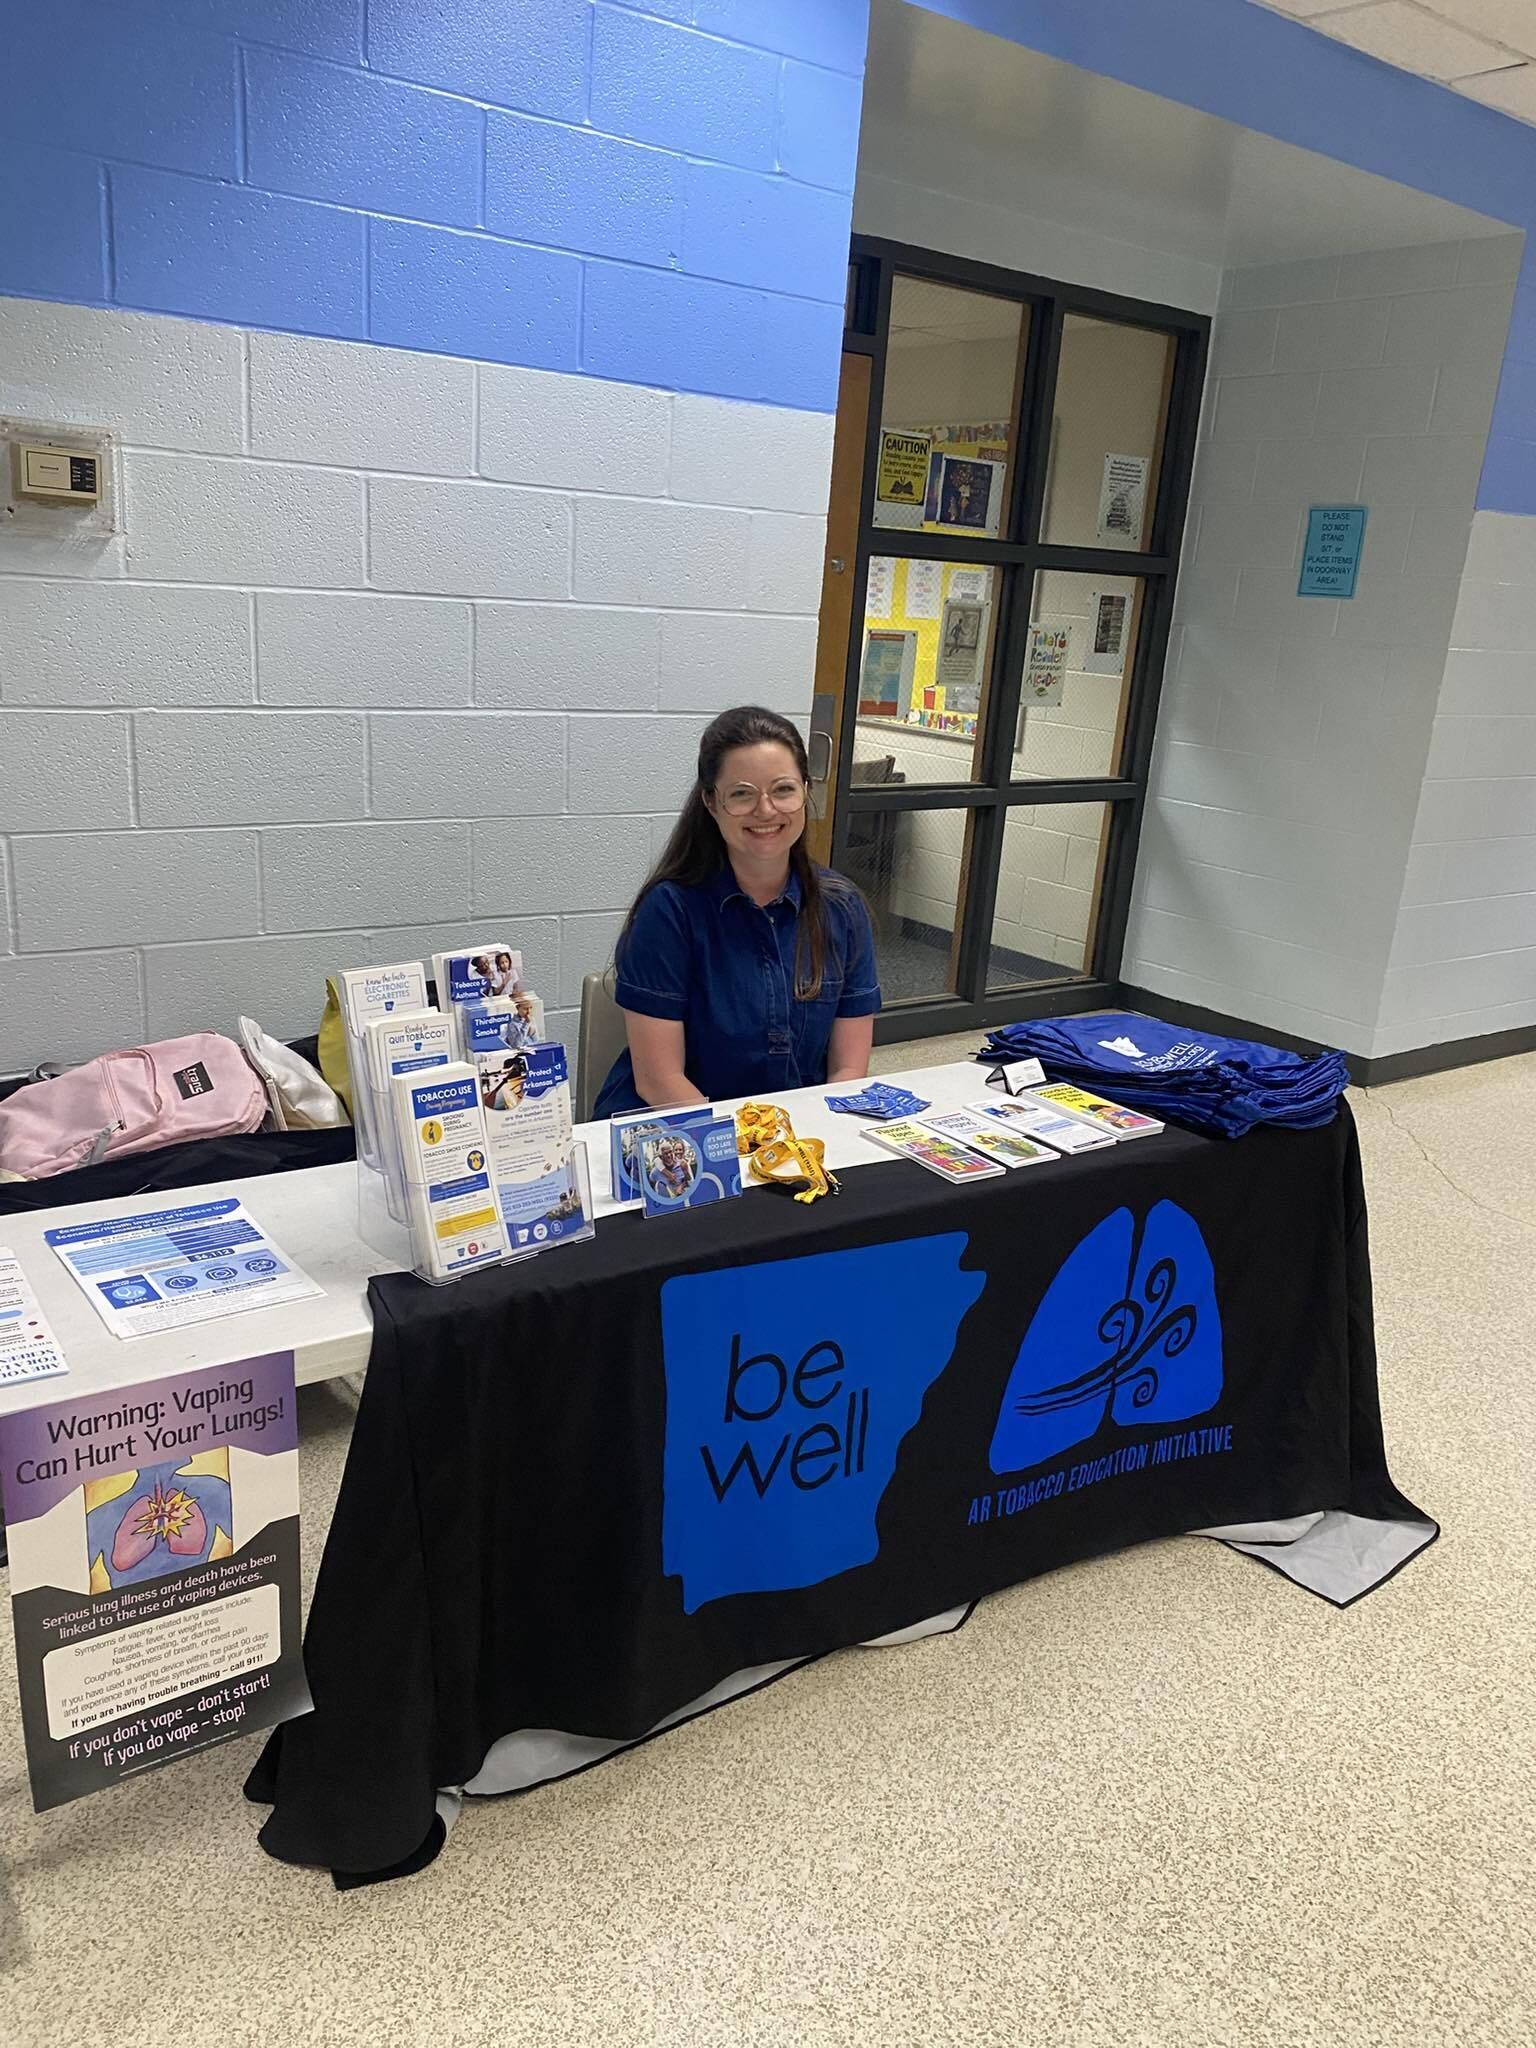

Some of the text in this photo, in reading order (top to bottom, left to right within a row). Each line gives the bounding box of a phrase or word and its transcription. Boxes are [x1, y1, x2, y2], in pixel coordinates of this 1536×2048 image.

[886, 438, 927, 454] CAUTION
[364, 981, 410, 995] ELECTRONIC
[367, 990, 410, 1003] CIGARETTES
[455, 981, 480, 990] Tobacco
[455, 991, 479, 1000] Asthma
[389, 1029, 446, 1044] QUIT TOBACCO?
[475, 1015, 510, 1026] Thirdhand
[475, 1028, 499, 1037] Smoke
[187, 1068, 204, 1094] trans
[523, 1079, 553, 1090] Arkansas
[528, 1068, 552, 1078] Protect
[416, 1085, 472, 1104] TOBACCO USE
[27, 1355, 57, 1365] FOR
[32, 1362, 60, 1372] ARE
[724, 1334, 845, 1423] be
[47, 1379, 254, 1444] Warning: Vaping
[16, 1398, 285, 1485] Can Hurt Your Lungs!
[700, 1387, 869, 1503] well
[968, 1425, 1233, 1526] AR TOBACCO EDUCATION INITIATIVE
[42, 1554, 277, 1629] Serious lung illness and death have been
[59, 1571, 263, 1640] linked to the use of vaping devices.
[74, 1637, 116, 1657] Symptoms
[118, 1633, 126, 1643] of
[183, 1610, 199, 1624] lung
[201, 1605, 224, 1617] illness
[112, 1652, 143, 1665] Nausea,
[191, 1626, 220, 1641] diarrhea
[113, 1640, 142, 1655] Fatigue,
[168, 1630, 176, 1638] or
[178, 1621, 202, 1637] weight
[204, 1617, 219, 1627] loss
[68, 1694, 84, 1708] you
[85, 1687, 104, 1700] have
[106, 1679, 125, 1694] used
[134, 1667, 158, 1684] vaping
[161, 1657, 184, 1674] device
[186, 1651, 208, 1666] within
[210, 1646, 221, 1657] the
[224, 1642, 239, 1656] past
[241, 1638, 250, 1646] 90
[252, 1631, 269, 1645] days
[84, 1667, 124, 1685] Coughing,
[125, 1655, 162, 1672] shortness
[164, 1648, 172, 1659] of
[211, 1630, 230, 1643] chest
[232, 1626, 247, 1640] pain
[64, 1706, 79, 1718] and
[81, 1693, 123, 1713] experience
[124, 1686, 138, 1700] any
[140, 1680, 148, 1690] of
[150, 1673, 170, 1688] these
[213, 1655, 226, 1666] call
[228, 1650, 243, 1662] your
[72, 1653, 263, 1728] If you are having trouble breathing call 911!
[69, 1744, 79, 1759] If
[84, 1735, 110, 1758] you
[113, 1719, 148, 1744] don't
[151, 1707, 183, 1729] vape
[198, 1689, 230, 1712] don't
[233, 1673, 271, 1699] start!
[103, 1751, 114, 1766] If
[117, 1743, 144, 1767] you
[146, 1734, 164, 1751] do
[166, 1721, 199, 1742] vape
[213, 1701, 247, 1727] stop!
